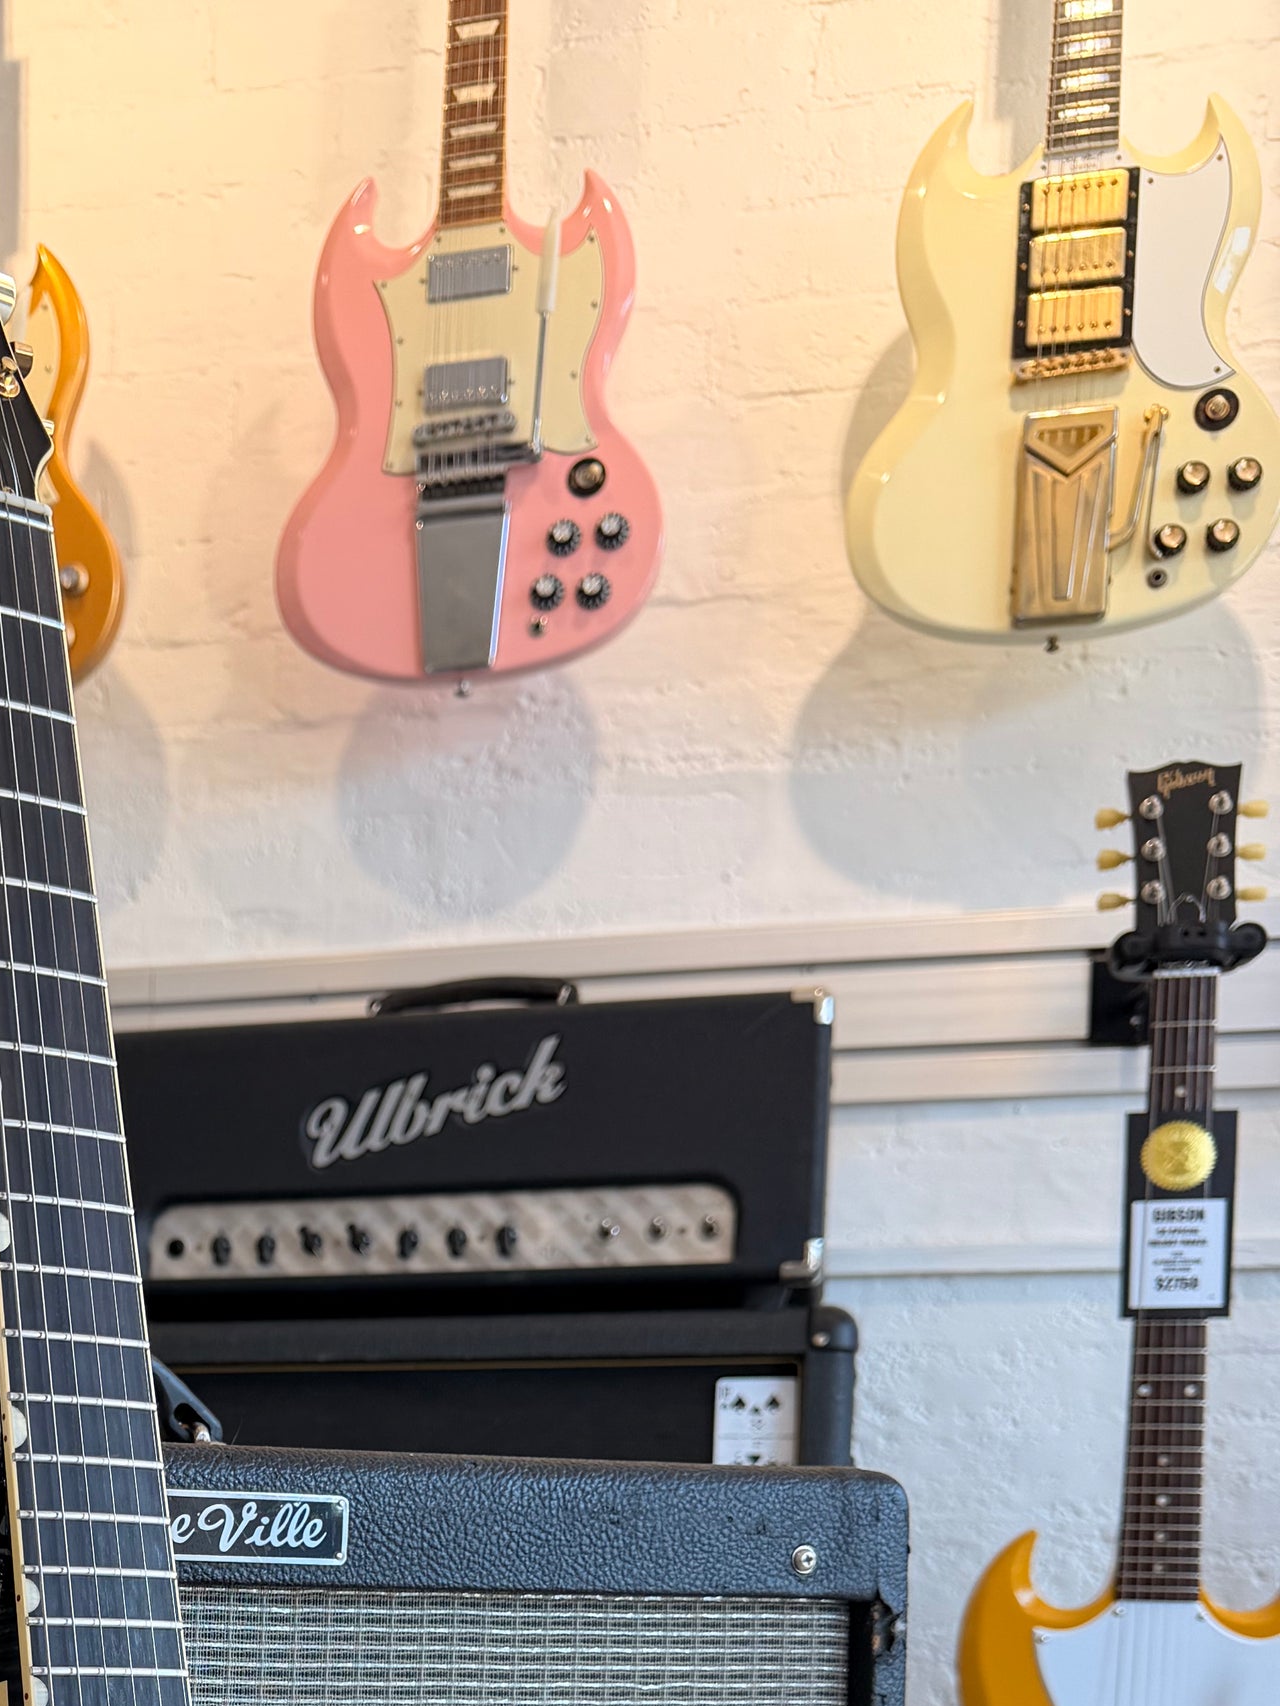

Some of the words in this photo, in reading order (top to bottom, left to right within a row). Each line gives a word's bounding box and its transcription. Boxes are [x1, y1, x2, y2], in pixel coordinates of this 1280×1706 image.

[306, 1033, 568, 1169] Ulbrick
[1153, 1207, 1205, 1223] GIBSON
[170, 1501, 327, 1552] eVille
